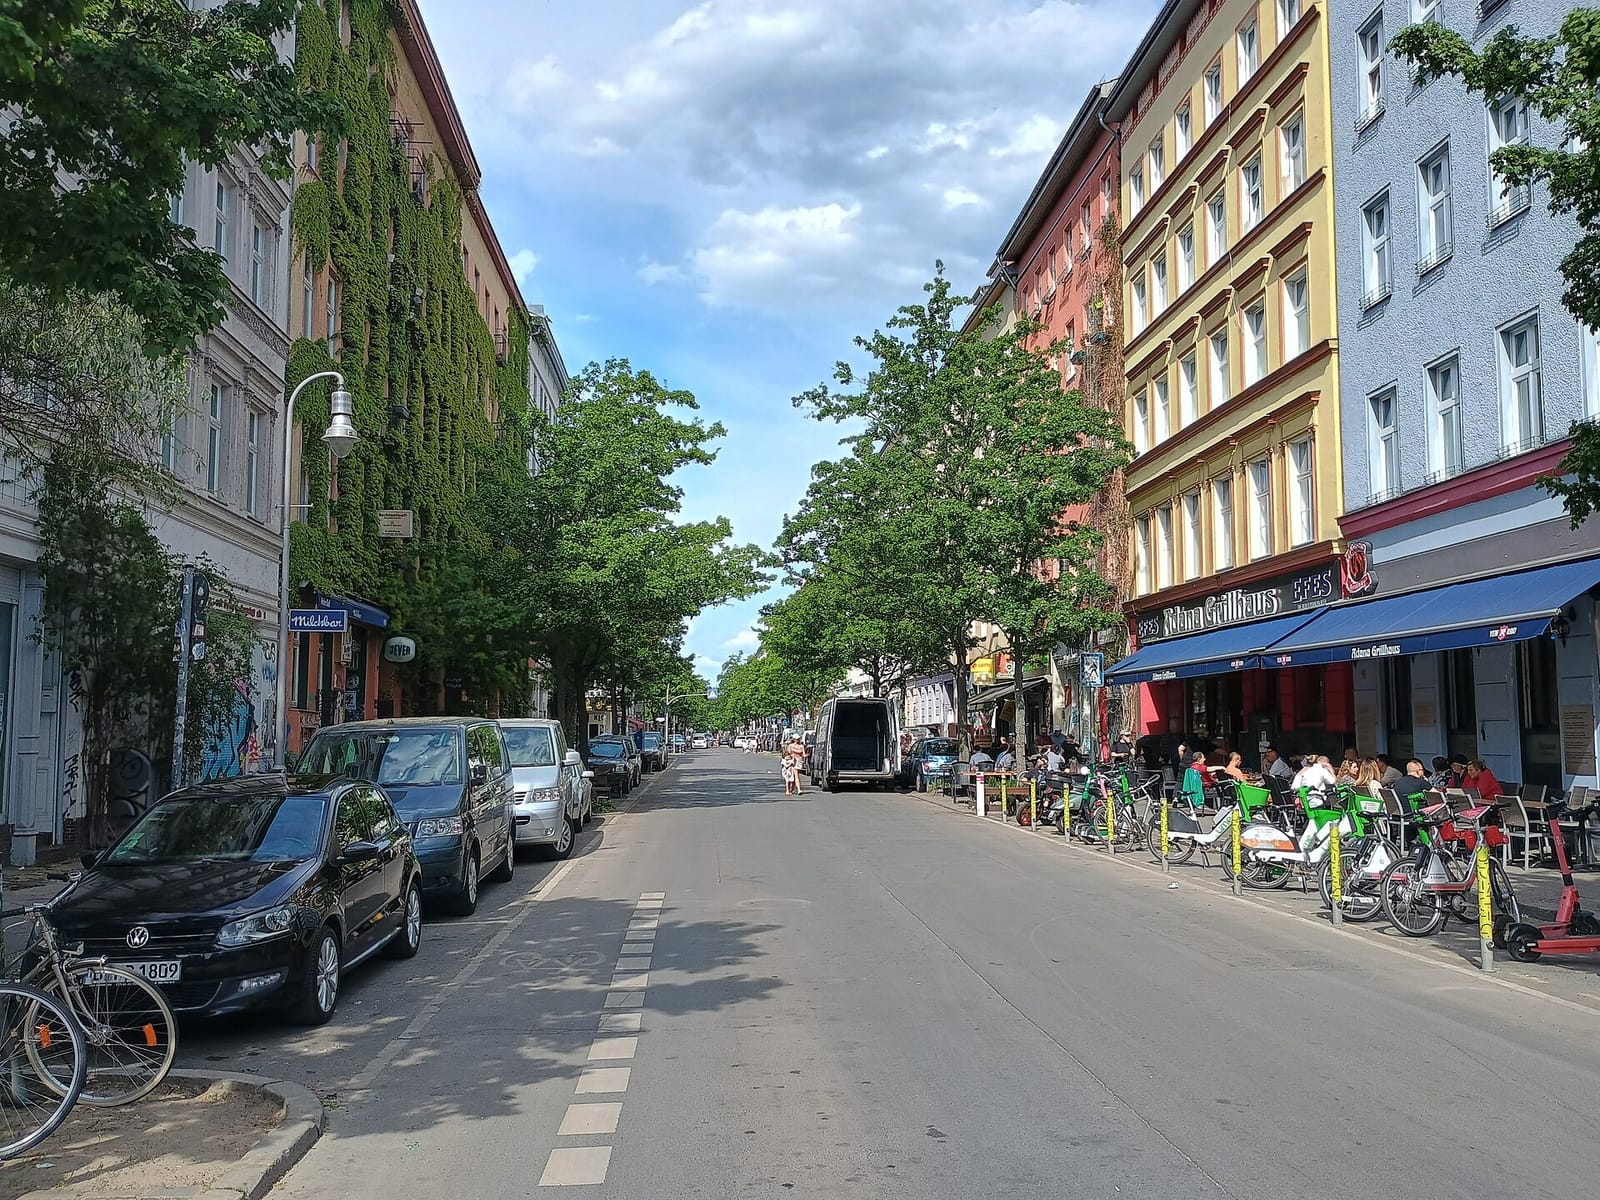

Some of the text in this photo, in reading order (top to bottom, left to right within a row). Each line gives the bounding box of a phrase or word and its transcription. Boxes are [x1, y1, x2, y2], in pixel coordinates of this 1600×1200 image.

[1293, 570, 1333, 602] EFES
[1162, 587, 1279, 636] Adana Grillhaus
[291, 615, 343, 628] Milchbar
[1138, 616, 1160, 638] EFES
[389, 644, 411, 657] JEVER
[1351, 643, 1401, 659] Adana Grillhaus
[1215, 816, 1232, 834] Lime
[139, 963, 178, 979] 1809
